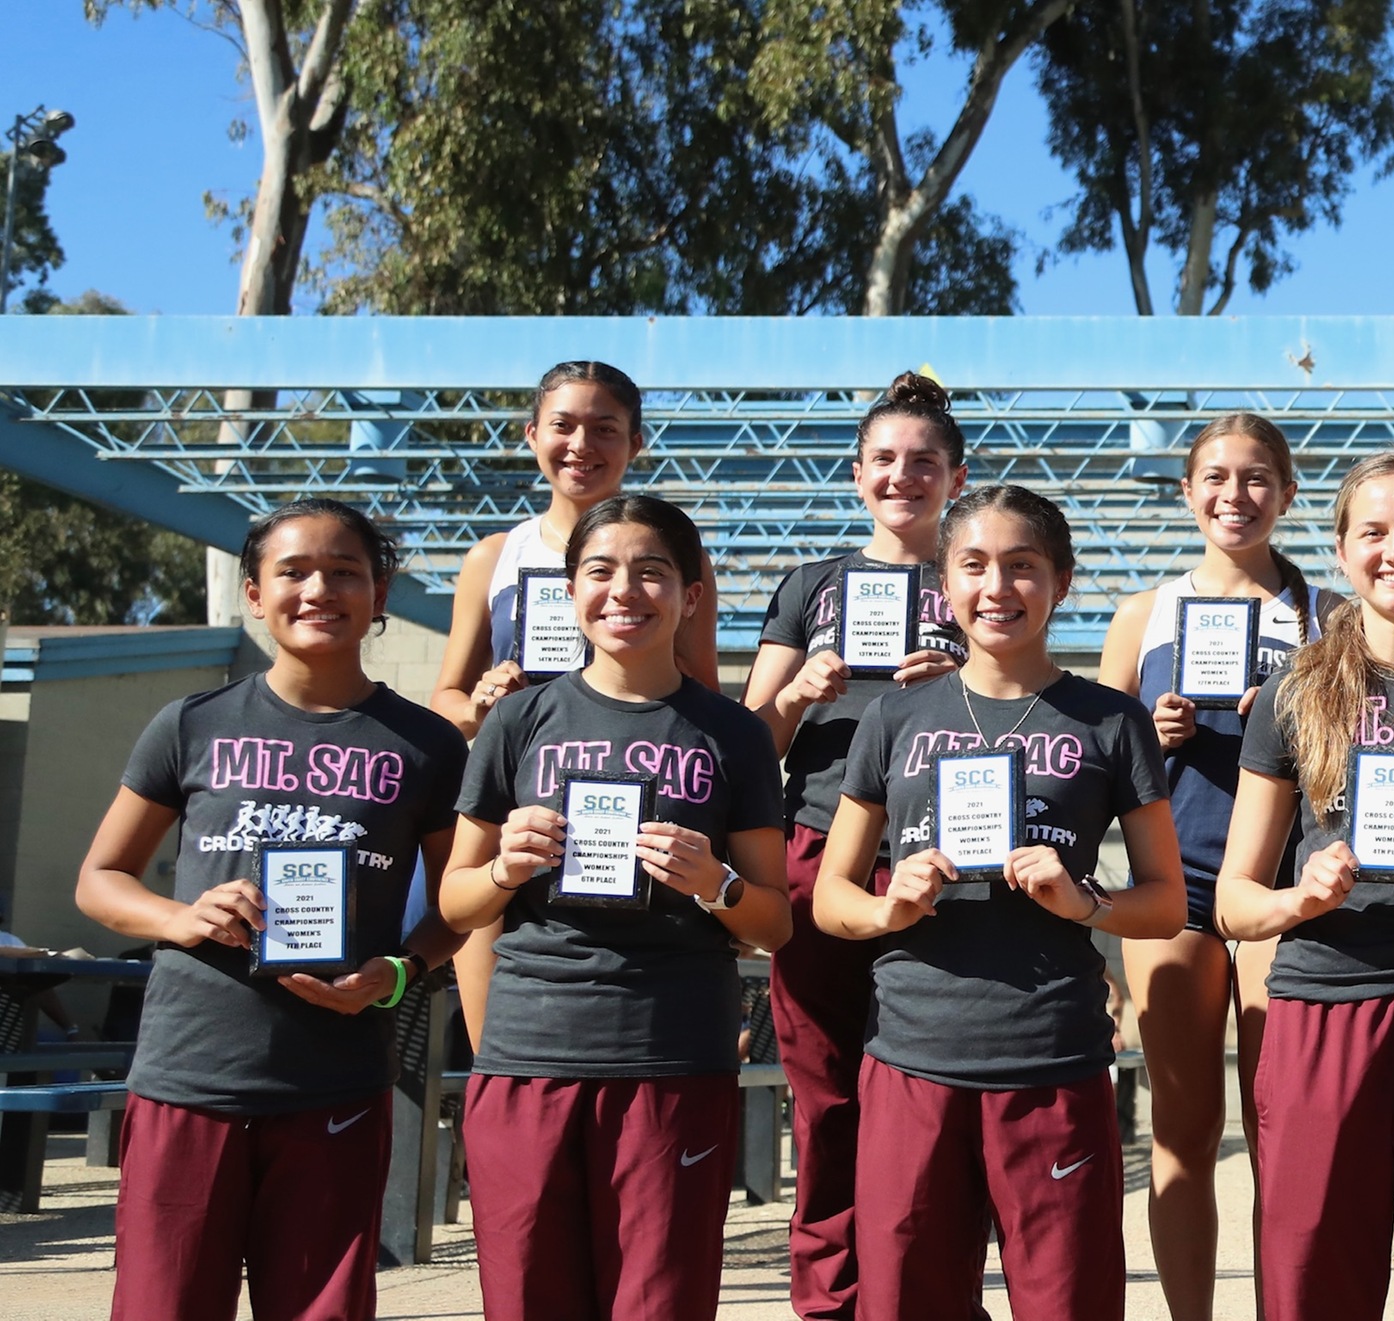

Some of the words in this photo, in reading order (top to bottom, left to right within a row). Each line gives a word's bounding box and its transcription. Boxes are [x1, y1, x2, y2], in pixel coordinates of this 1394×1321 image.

[860, 583, 895, 596] SCC
[1200, 614, 1235, 627] SCC
[211, 738, 299, 791] MT.
[307, 744, 403, 804] SAC
[955, 769, 995, 786] SCC
[584, 795, 626, 811] SCC
[948, 824, 1002, 832] CHAMPIONSHIPS
[198, 835, 255, 852] CROS
[598, 840, 629, 848] COUNTRY
[572, 852, 629, 860] CHAMPIONSHIPS
[283, 863, 327, 879] SCC
[275, 907, 299, 915] CROSS
